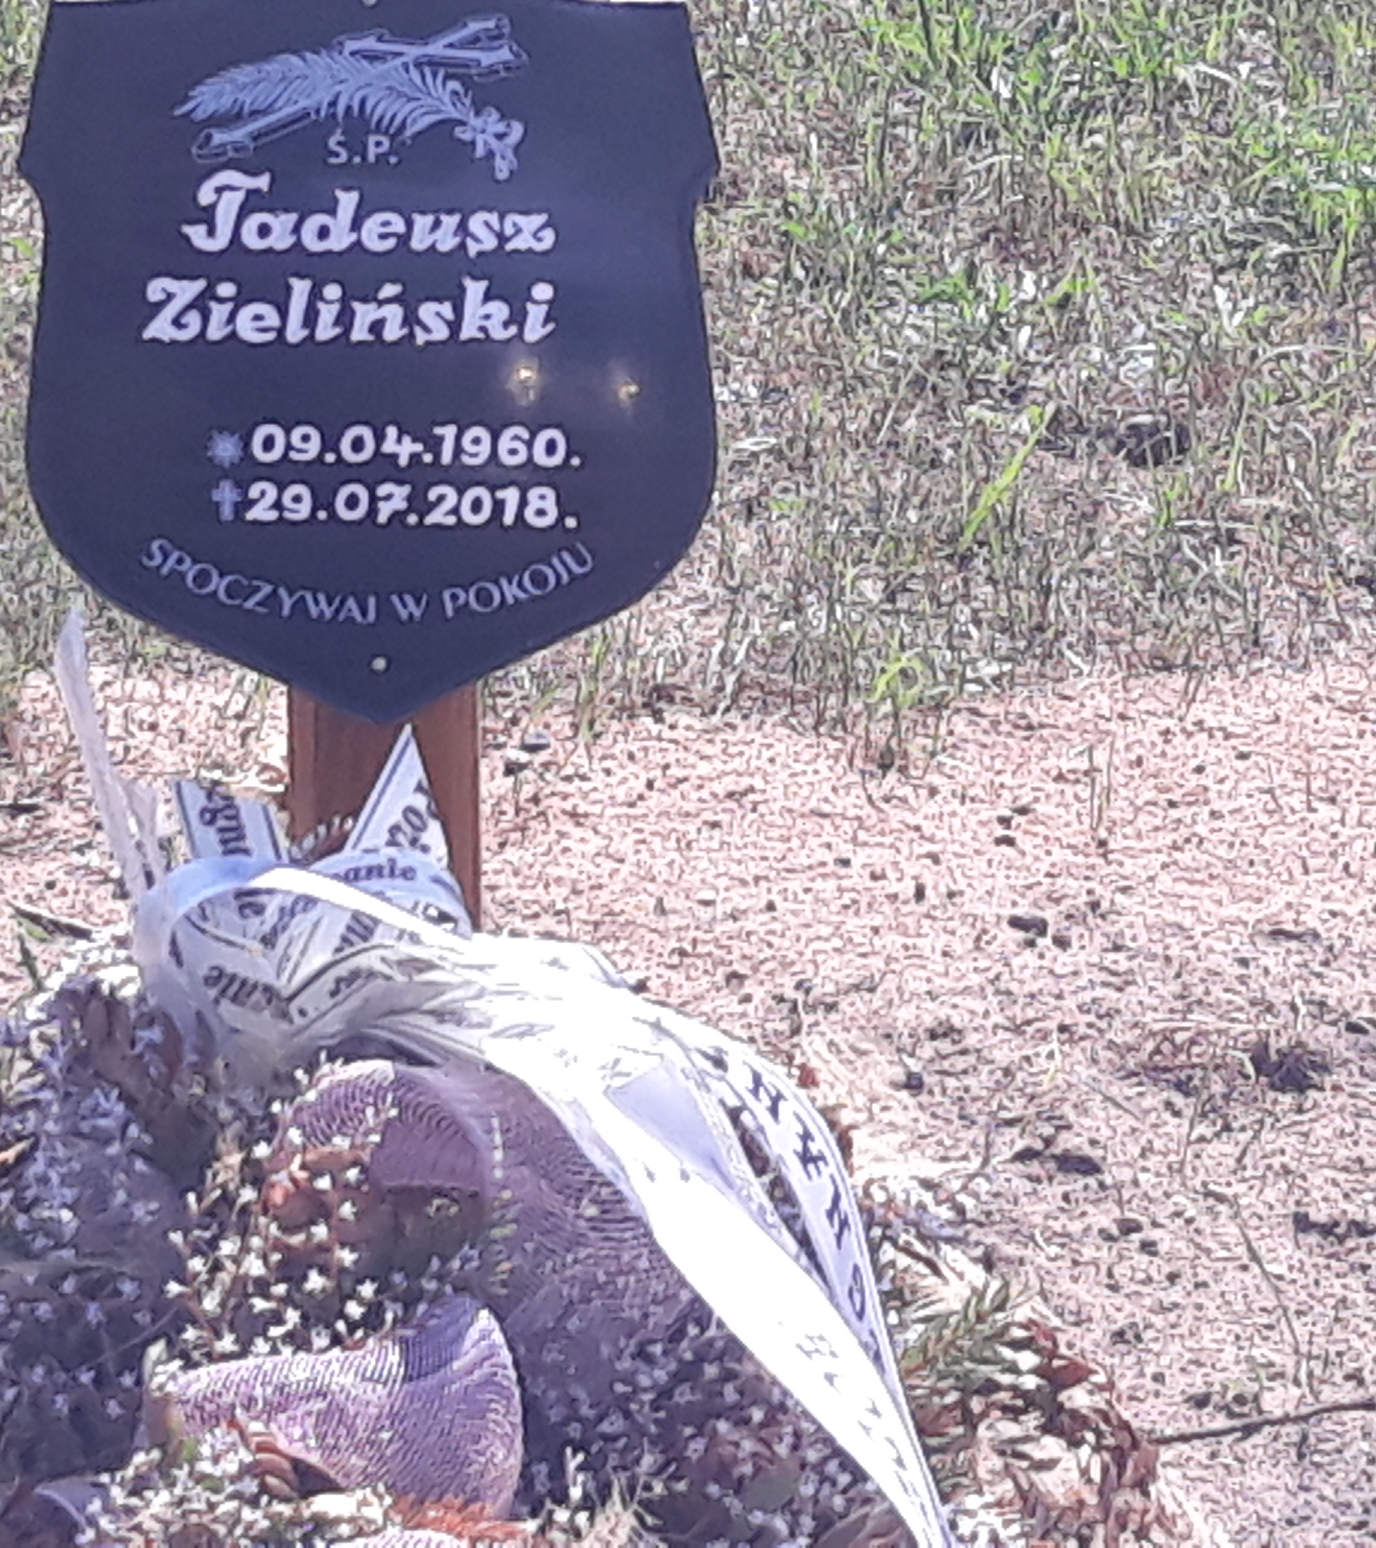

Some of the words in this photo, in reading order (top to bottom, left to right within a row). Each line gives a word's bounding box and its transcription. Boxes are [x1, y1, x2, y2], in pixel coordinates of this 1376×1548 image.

[181, 169, 556, 258] Tadeusz
[141, 276, 556, 346] Zieliński
[251, 422, 581, 468] 09.04.1960.
[243, 480, 579, 529] 29.07.2018.
[141, 537, 377, 625] SPOCZYWAJ
[390, 590, 428, 622] W
[442, 541, 594, 620] POKOJU
